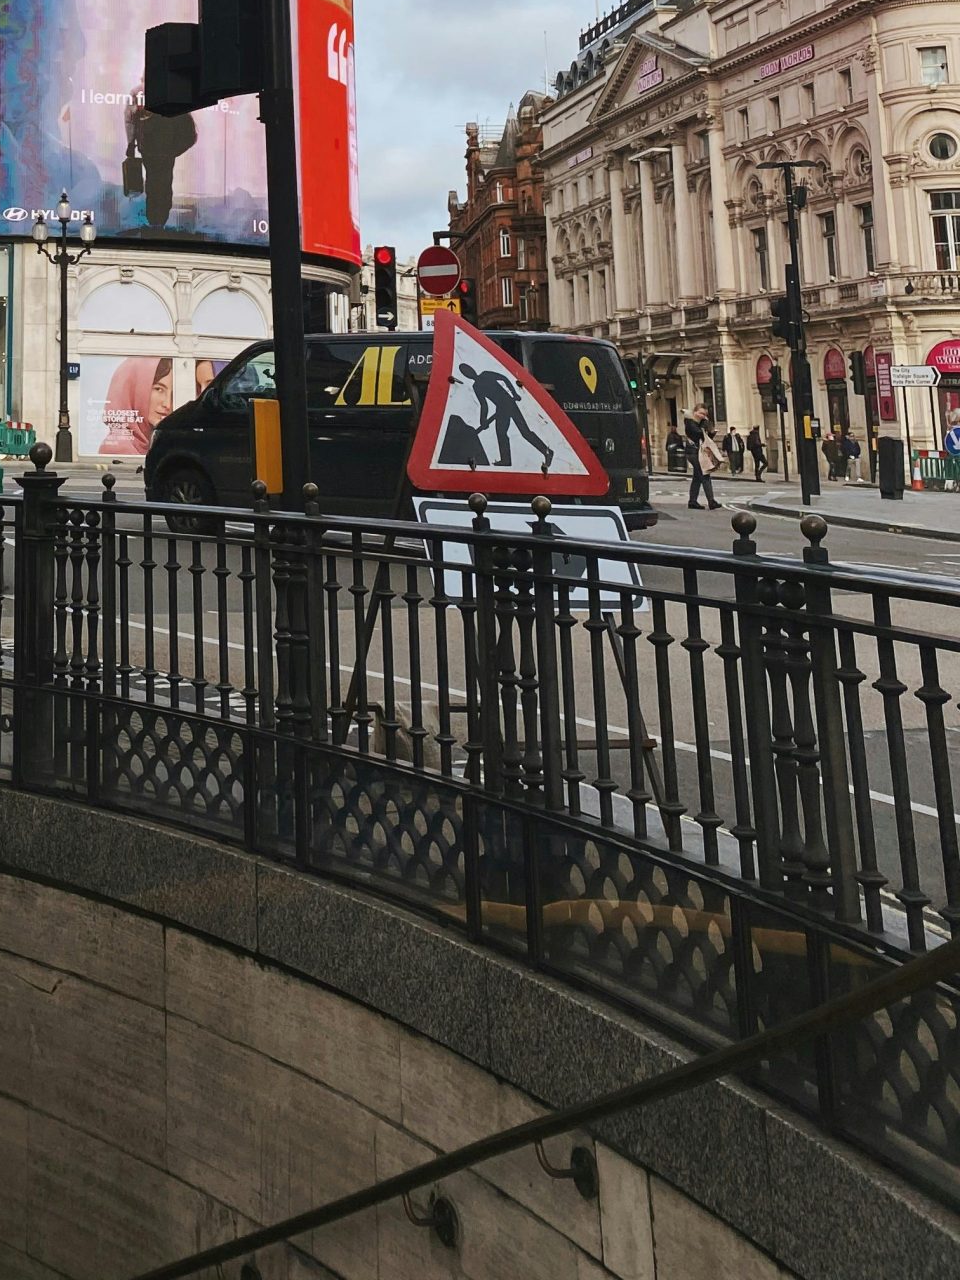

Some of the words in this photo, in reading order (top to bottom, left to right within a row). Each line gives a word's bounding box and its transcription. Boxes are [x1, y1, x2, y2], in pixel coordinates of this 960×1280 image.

[759, 60, 781, 79] BODY
[780, 44, 814, 71] WORLDS
[89, 89, 133, 105] learn
[563, 402, 599, 410] DOWNLOAD
